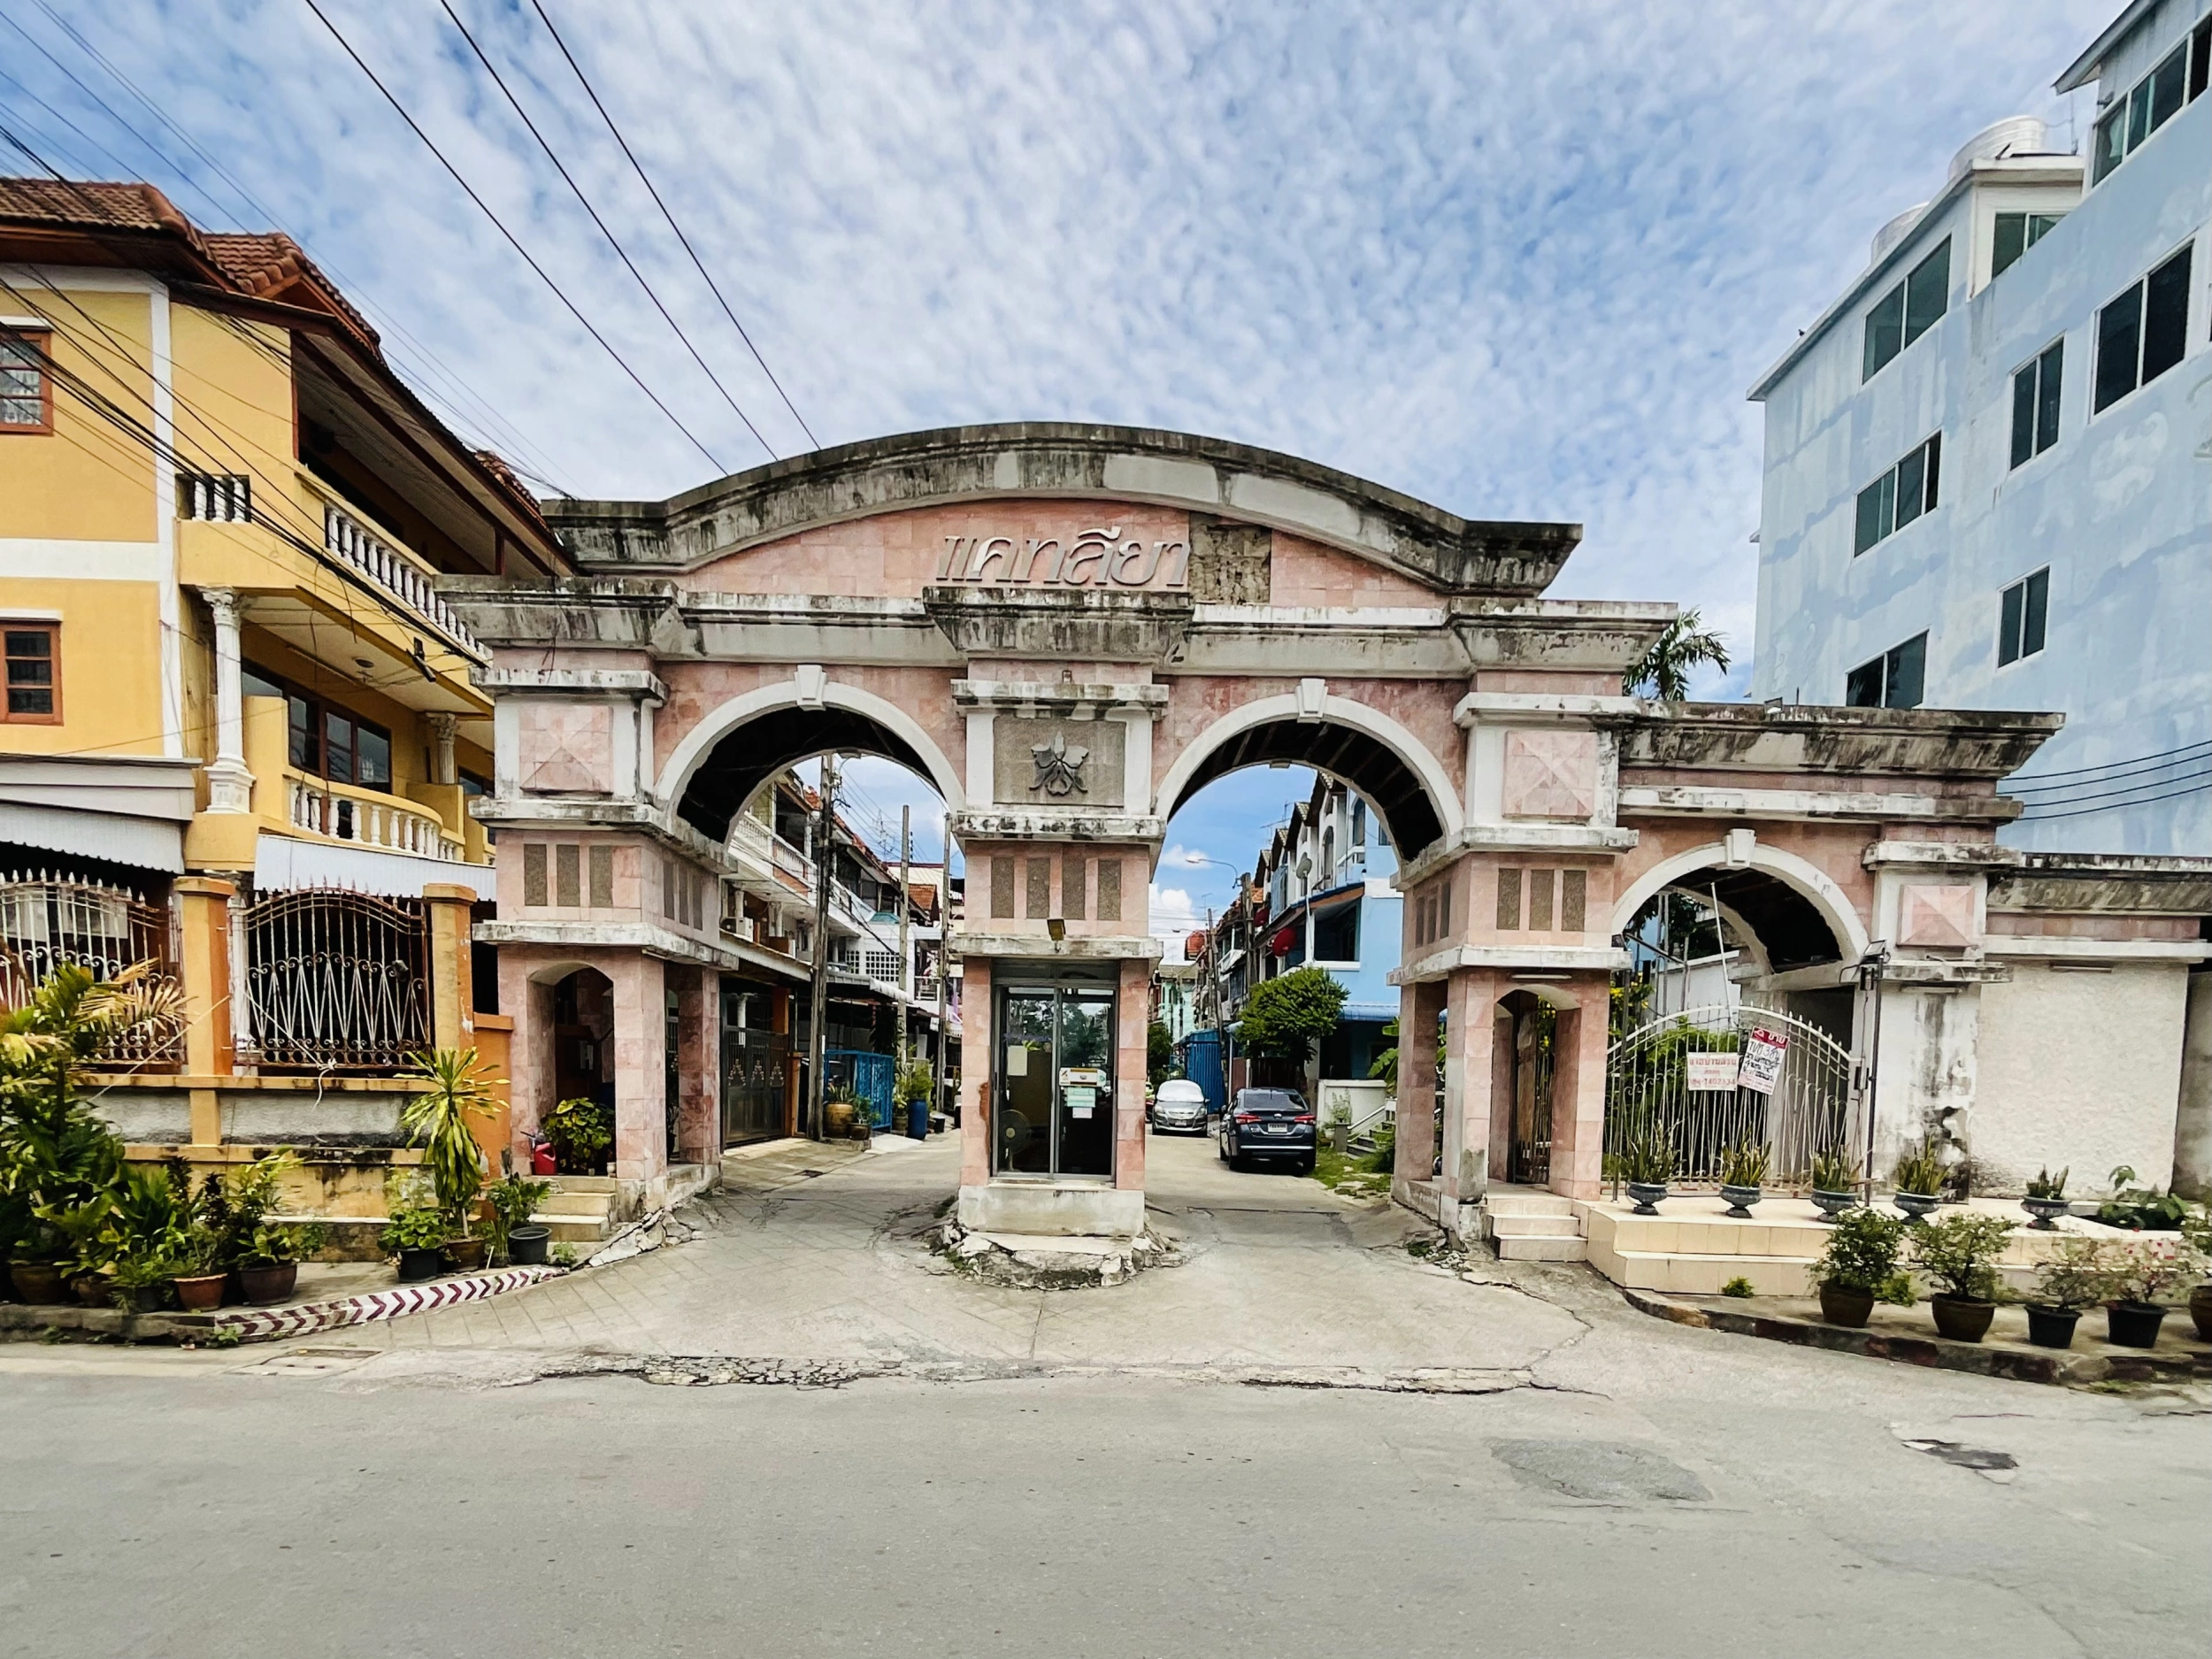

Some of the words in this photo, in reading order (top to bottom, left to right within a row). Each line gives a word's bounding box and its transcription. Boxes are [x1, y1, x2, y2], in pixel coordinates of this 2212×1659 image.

[935, 526, 1190, 587] แคทลียา
[1768, 1033, 1786, 1044] ขาย
